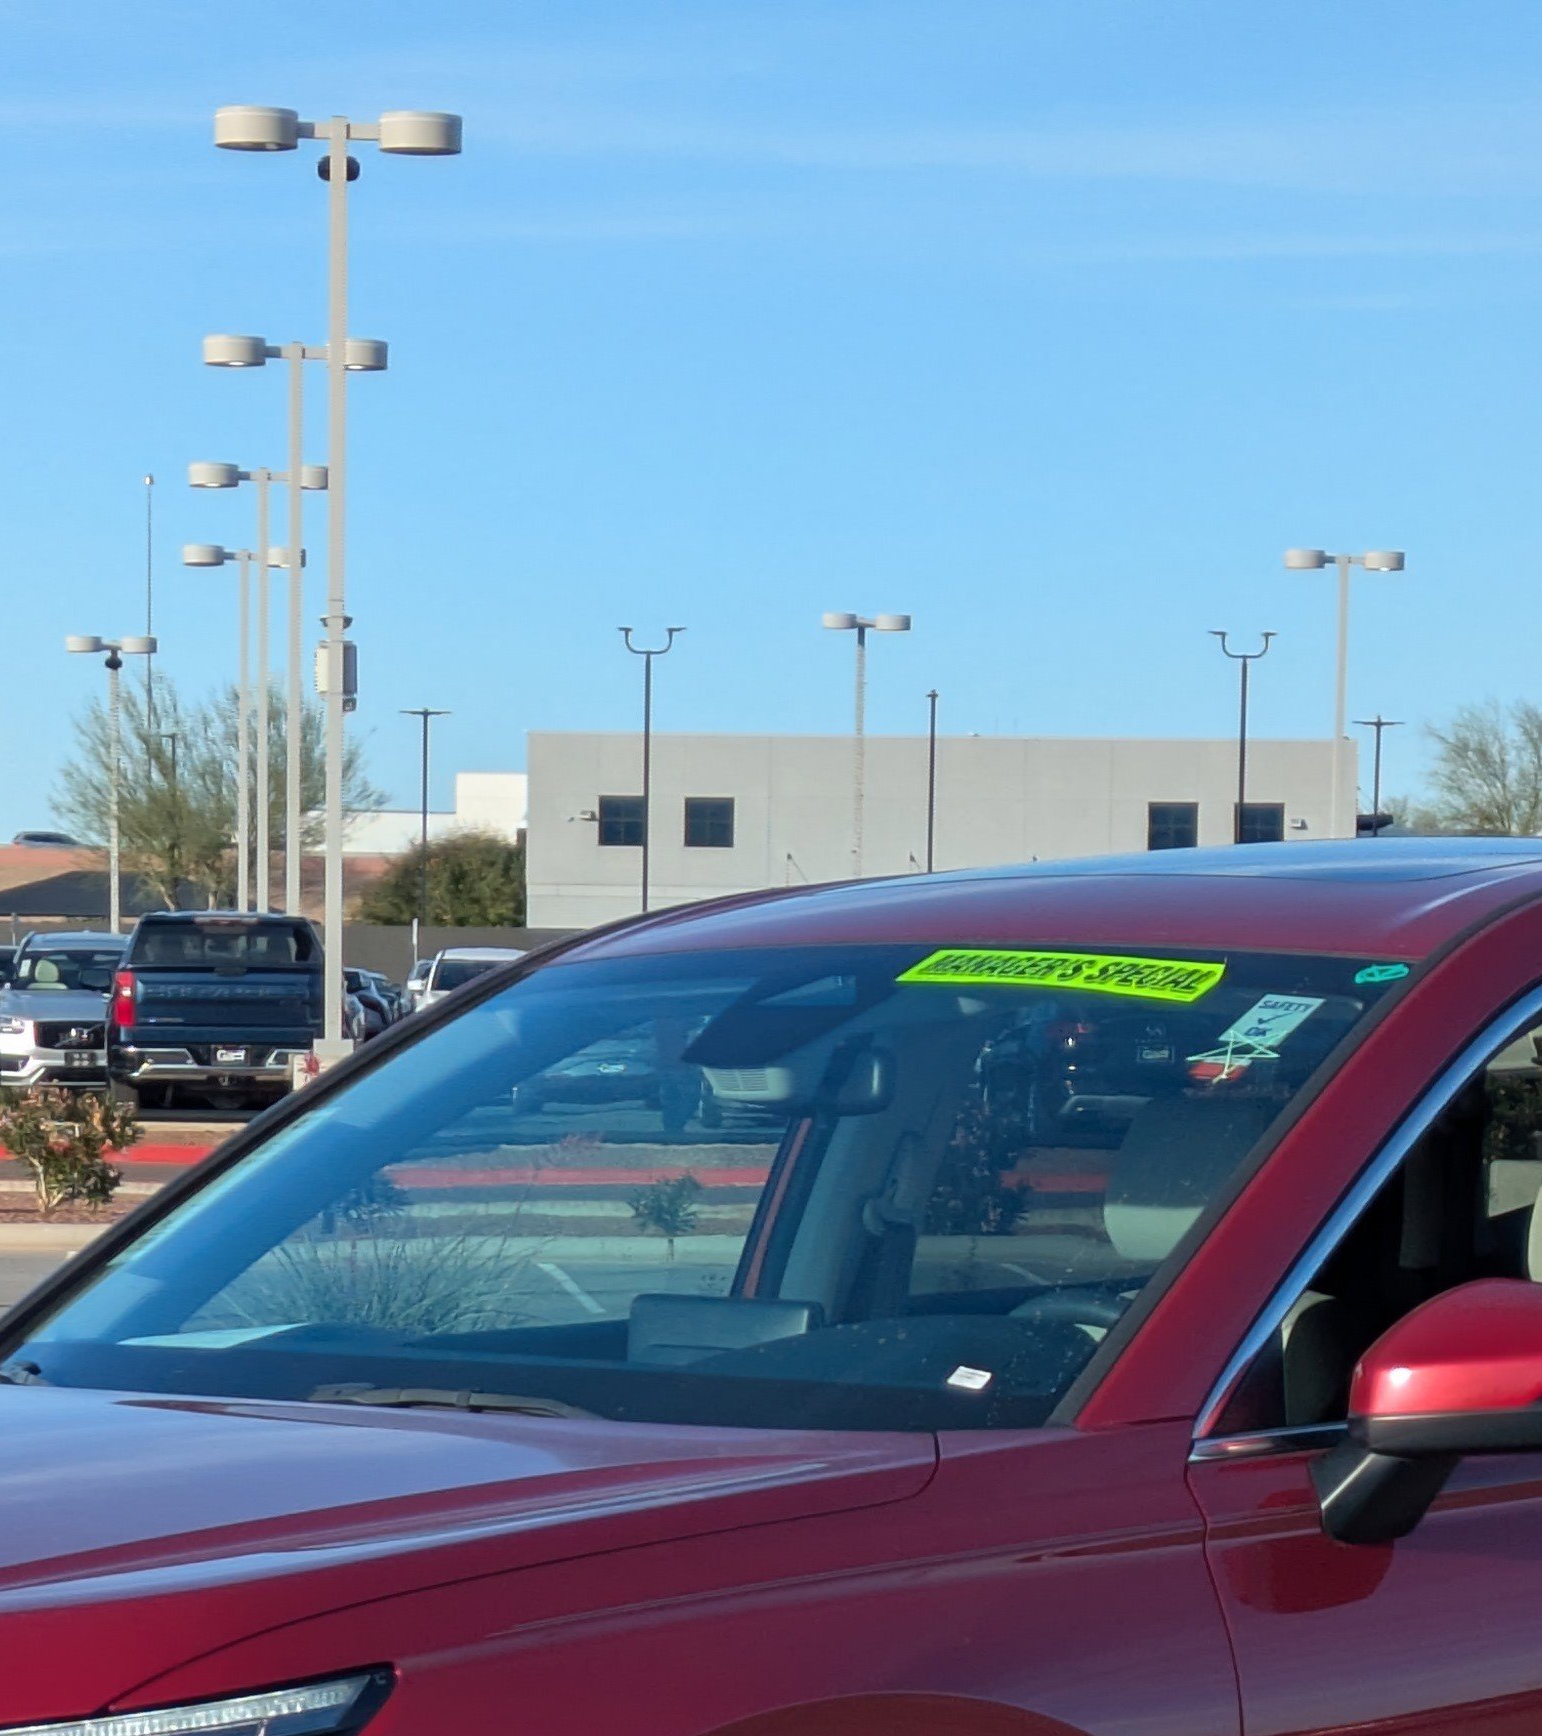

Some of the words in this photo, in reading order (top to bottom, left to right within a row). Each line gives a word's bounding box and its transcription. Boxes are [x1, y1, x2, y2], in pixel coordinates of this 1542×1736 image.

[923, 954, 1096, 981] MANAGER'S
[1085, 960, 1215, 992] SPECIAL
[1258, 1000, 1315, 1012] SAFETY
